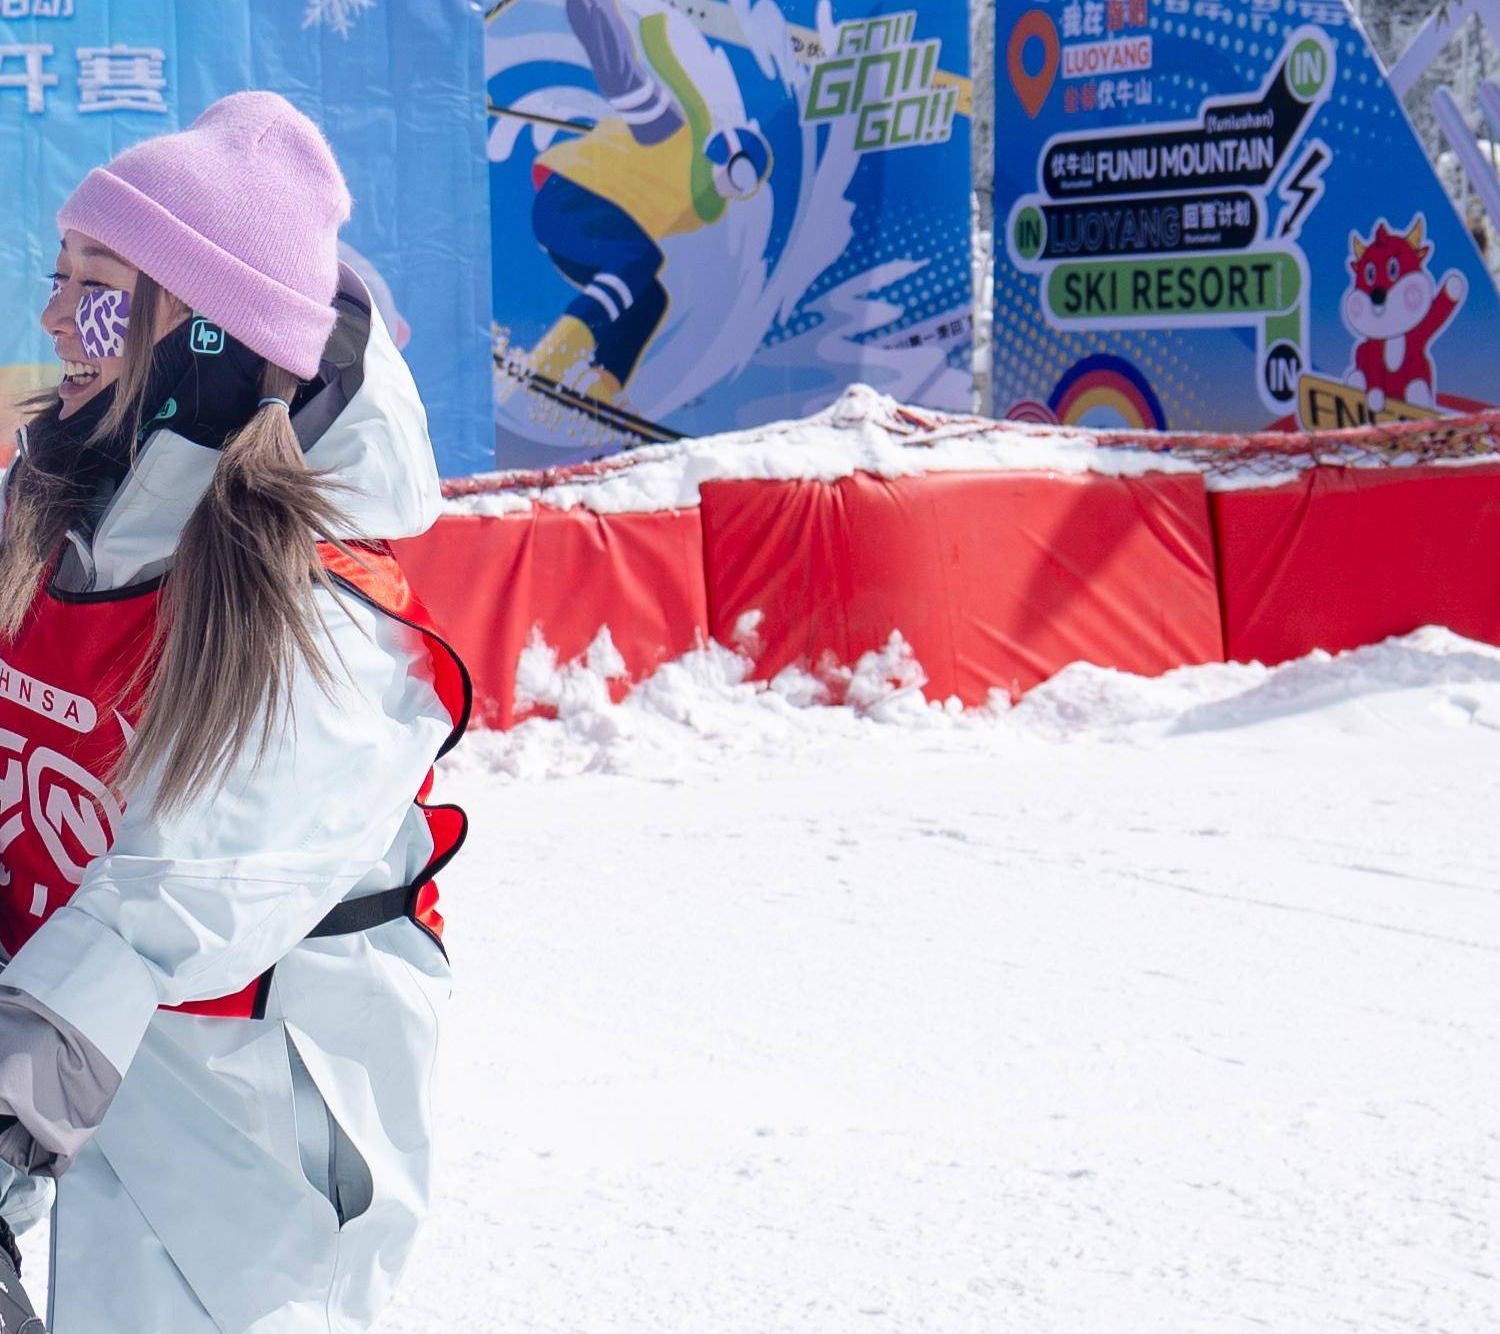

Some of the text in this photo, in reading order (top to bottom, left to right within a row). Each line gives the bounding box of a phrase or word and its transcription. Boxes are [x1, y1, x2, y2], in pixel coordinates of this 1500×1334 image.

[1064, 42, 1150, 75] LUOYANG
[1293, 50, 1322, 87] IN
[1050, 137, 1275, 183] 伏牛山 FUNIU MOUNTAIN
[1018, 216, 1042, 249] IN
[1051, 206, 1181, 253] LUOYANG
[1063, 267, 1117, 313] SKI
[1132, 263, 1275, 309] RESORT
[1269, 356, 1297, 392] IN
